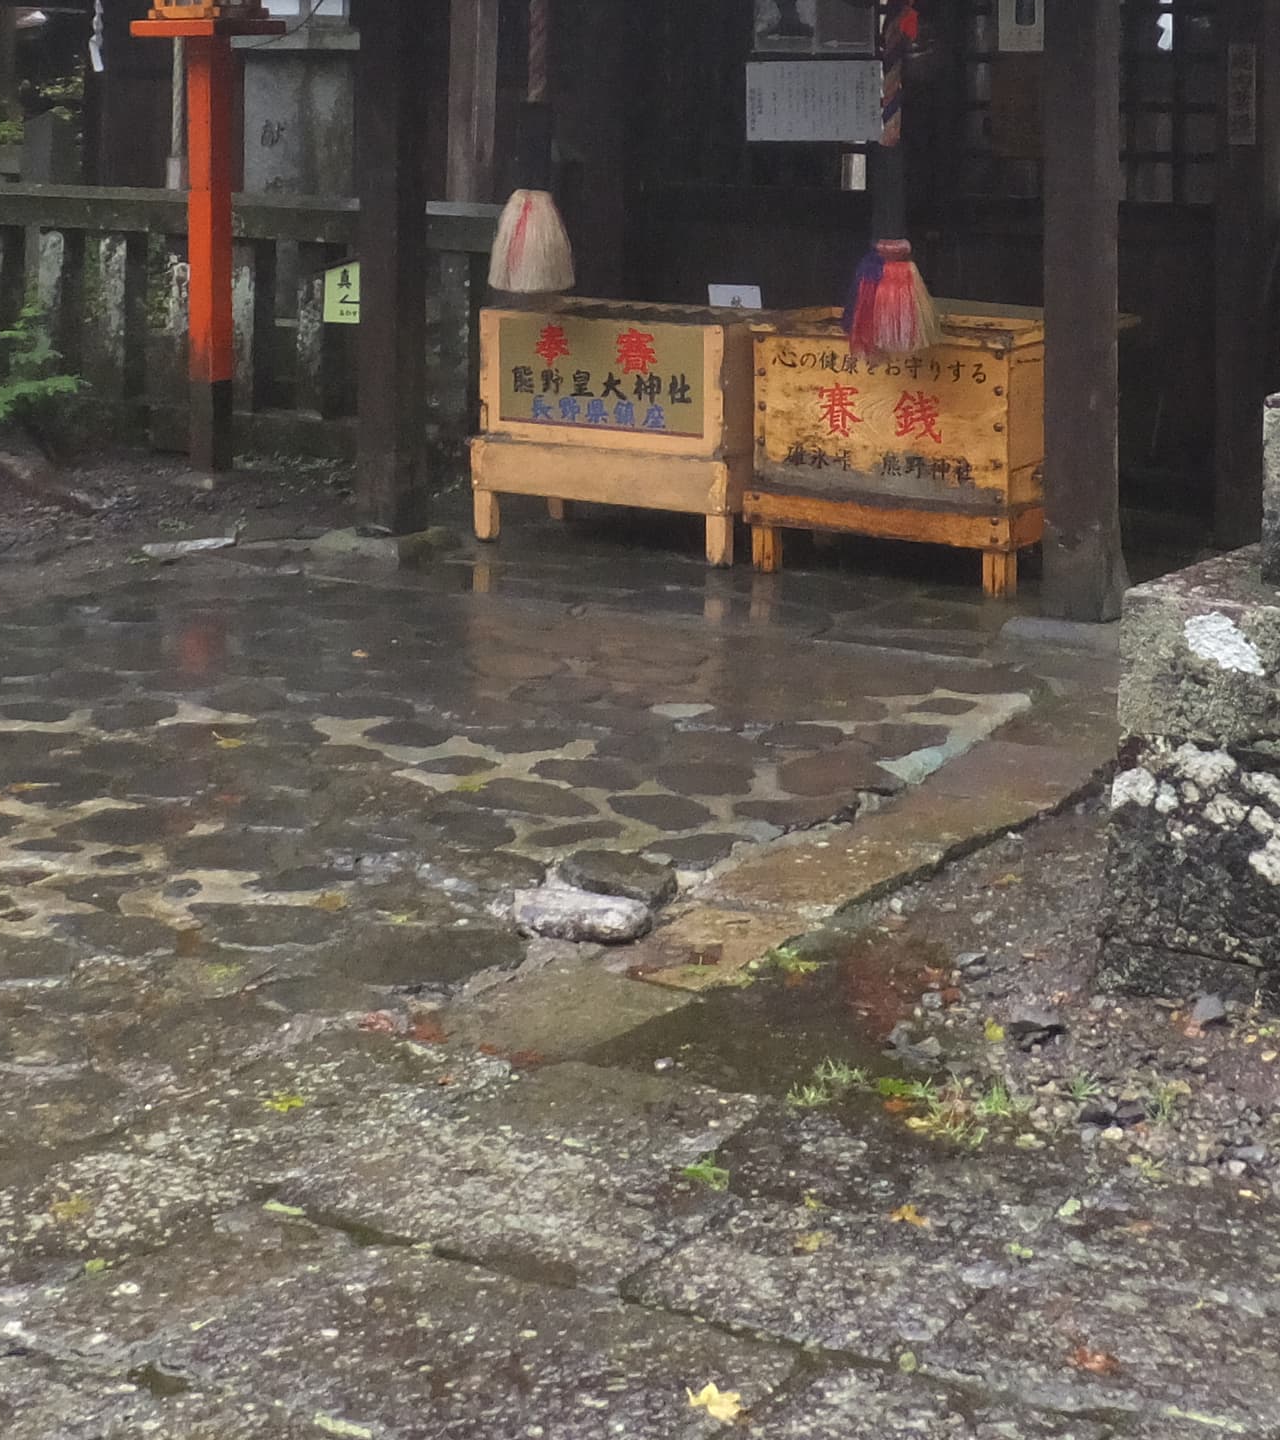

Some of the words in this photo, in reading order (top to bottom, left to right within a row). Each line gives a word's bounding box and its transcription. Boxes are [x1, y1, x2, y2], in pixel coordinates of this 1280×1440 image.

[772, 350, 988, 384] 心の健康をお守りする
[511, 365, 693, 405] 熊野皇大神社
[880, 449, 974, 482] 熊野神社
